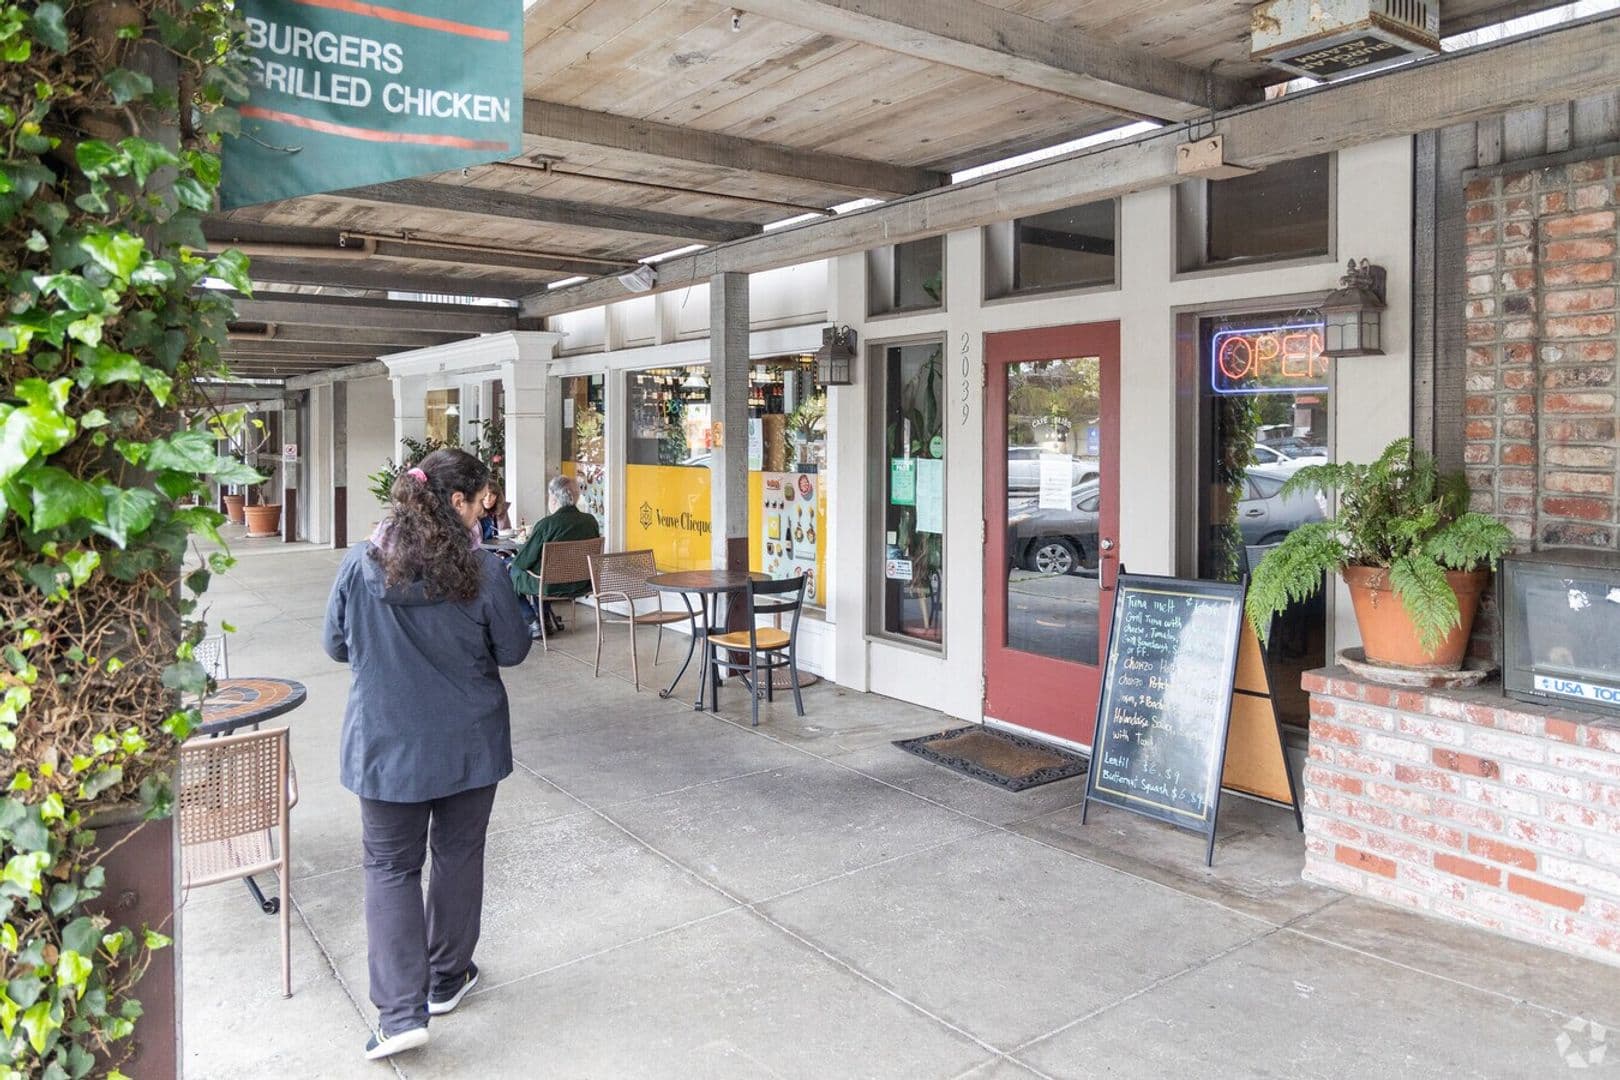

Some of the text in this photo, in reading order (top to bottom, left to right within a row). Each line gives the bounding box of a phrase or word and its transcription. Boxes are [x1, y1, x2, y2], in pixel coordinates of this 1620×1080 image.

[245, 17, 404, 74] BURGERS
[1294, 40, 1366, 63] ALARM
[248, 57, 511, 123] GRILLED CHICKEN
[1219, 334, 1328, 379] OPEN
[961, 331, 970, 426] 2039
[656, 508, 680, 529] Veuve
[1126, 595, 1148, 609] Tuna
[1554, 680, 1584, 696] USA
[1113, 729, 1130, 743] with
[1103, 751, 1130, 769] Lentil
[1141, 778, 1169, 795] Squash
